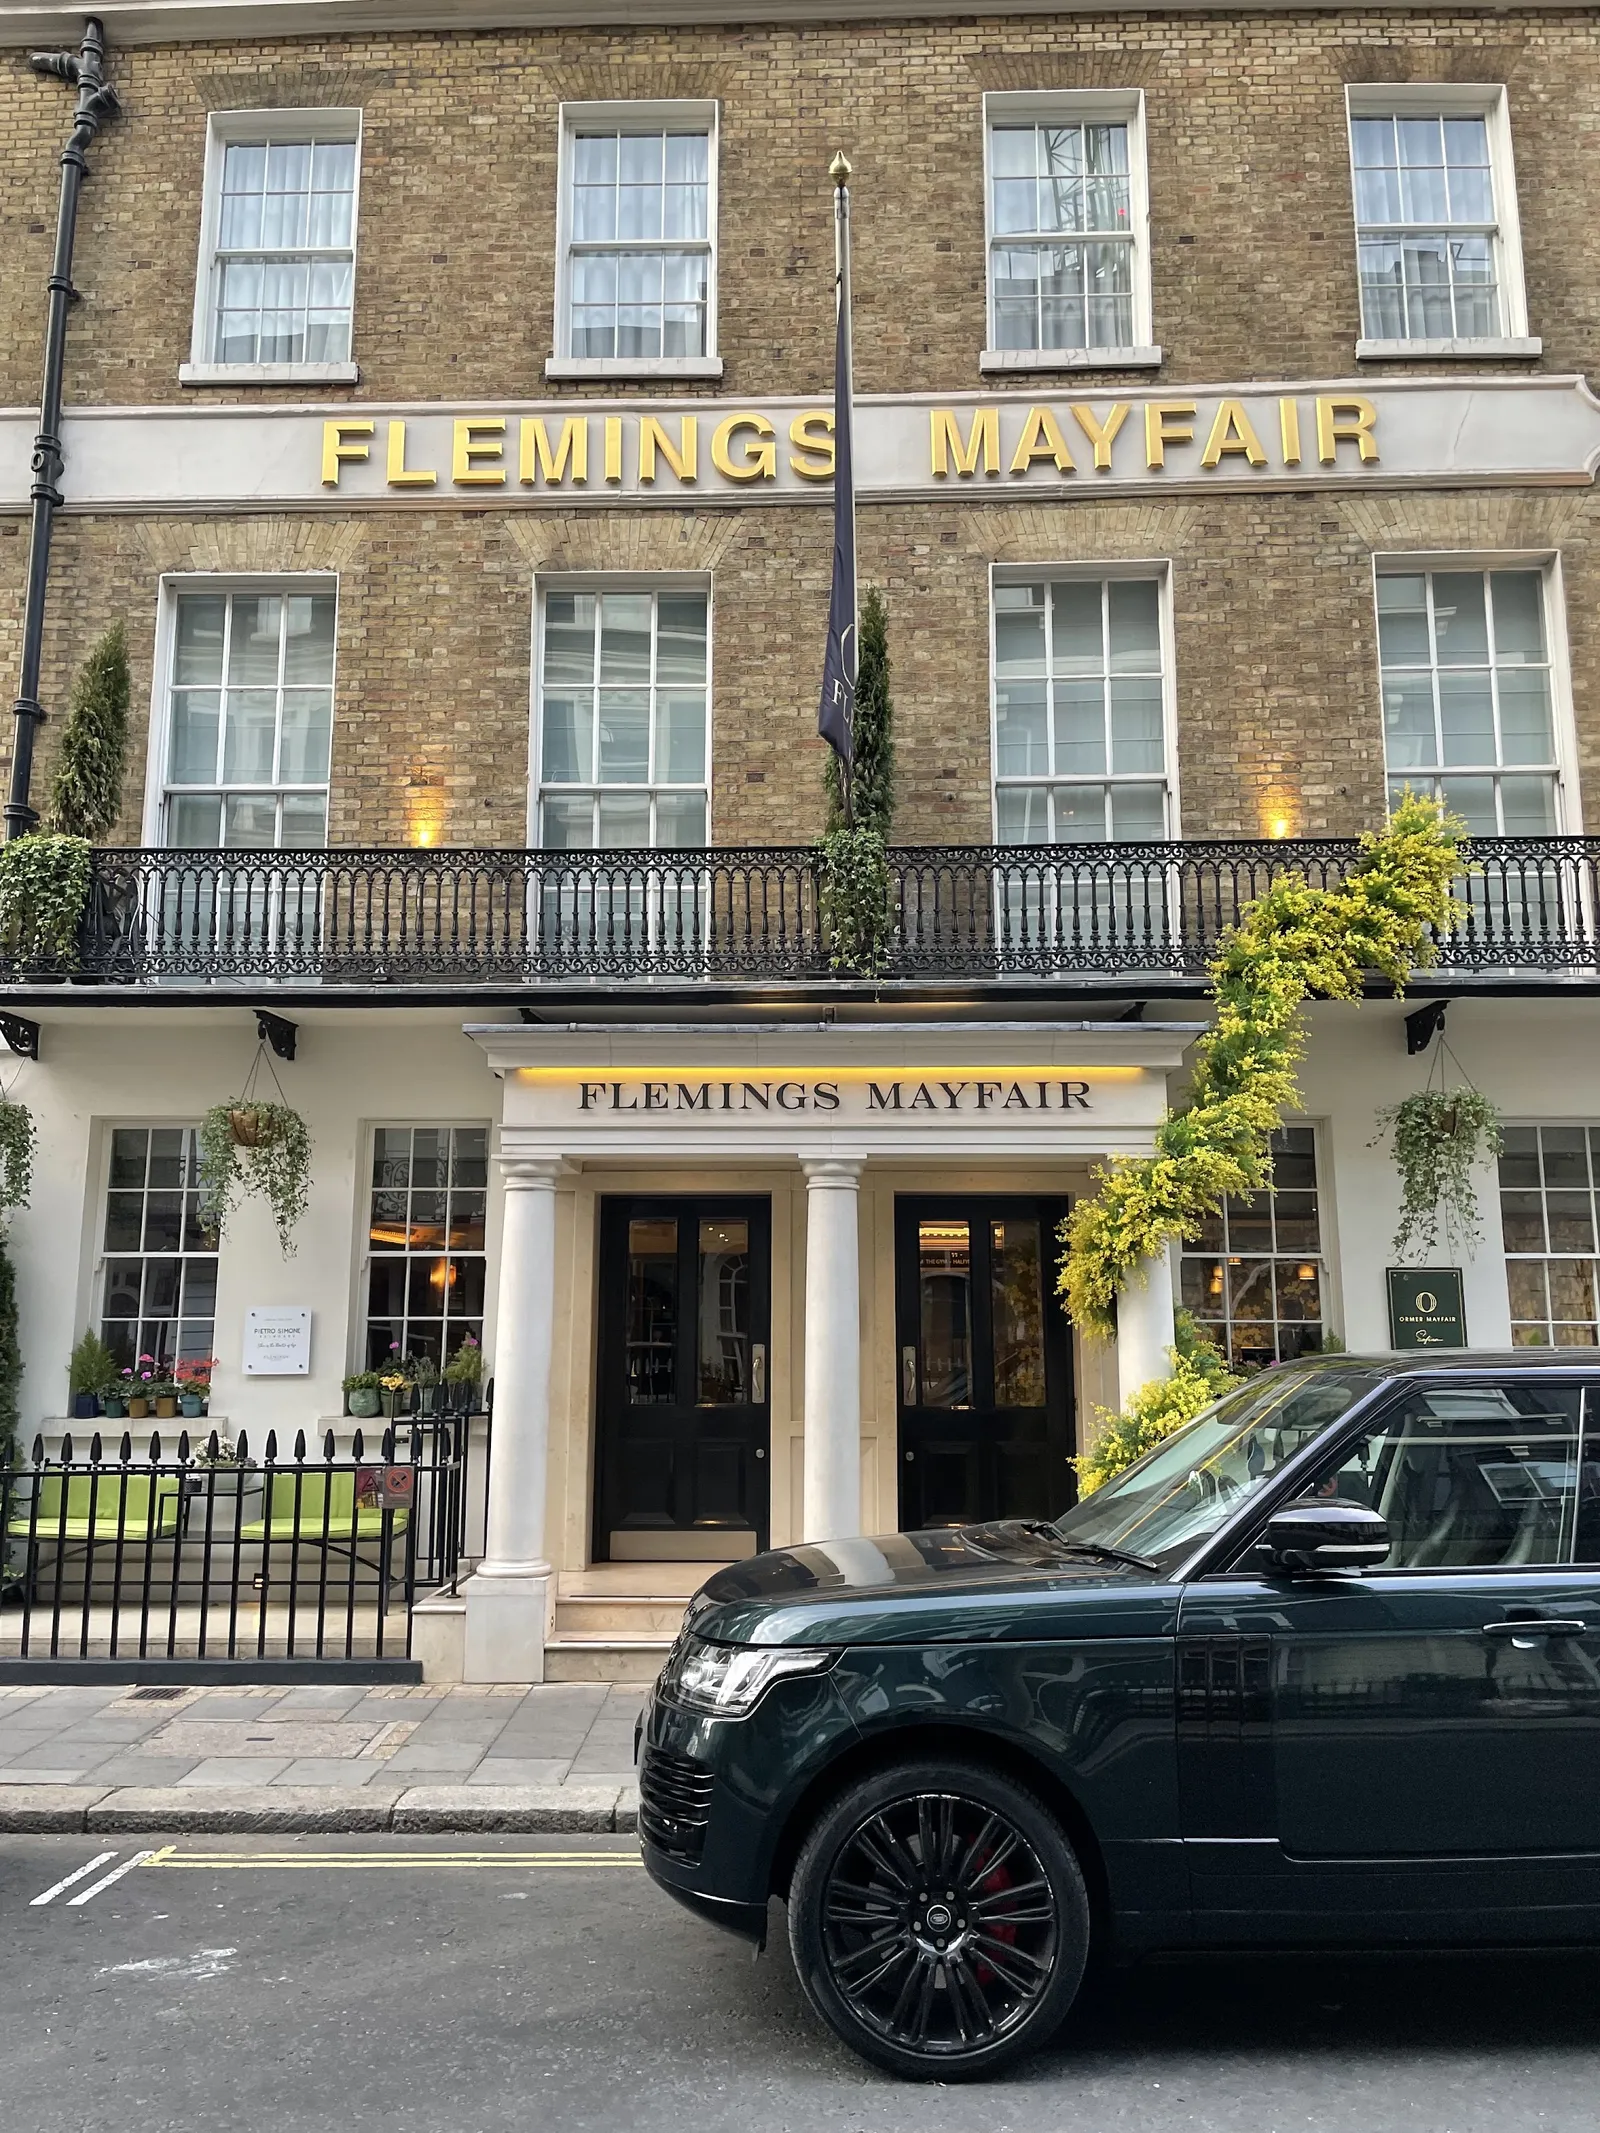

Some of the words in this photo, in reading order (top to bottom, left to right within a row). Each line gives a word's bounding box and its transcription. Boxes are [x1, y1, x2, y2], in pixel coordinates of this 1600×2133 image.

[321, 411, 836, 487] FLEMINGS
[929, 396, 1380, 478] MAYFAIR
[577, 1081, 840, 1111] FLEMINGS
[865, 1081, 1092, 1110] MAYFAIR
